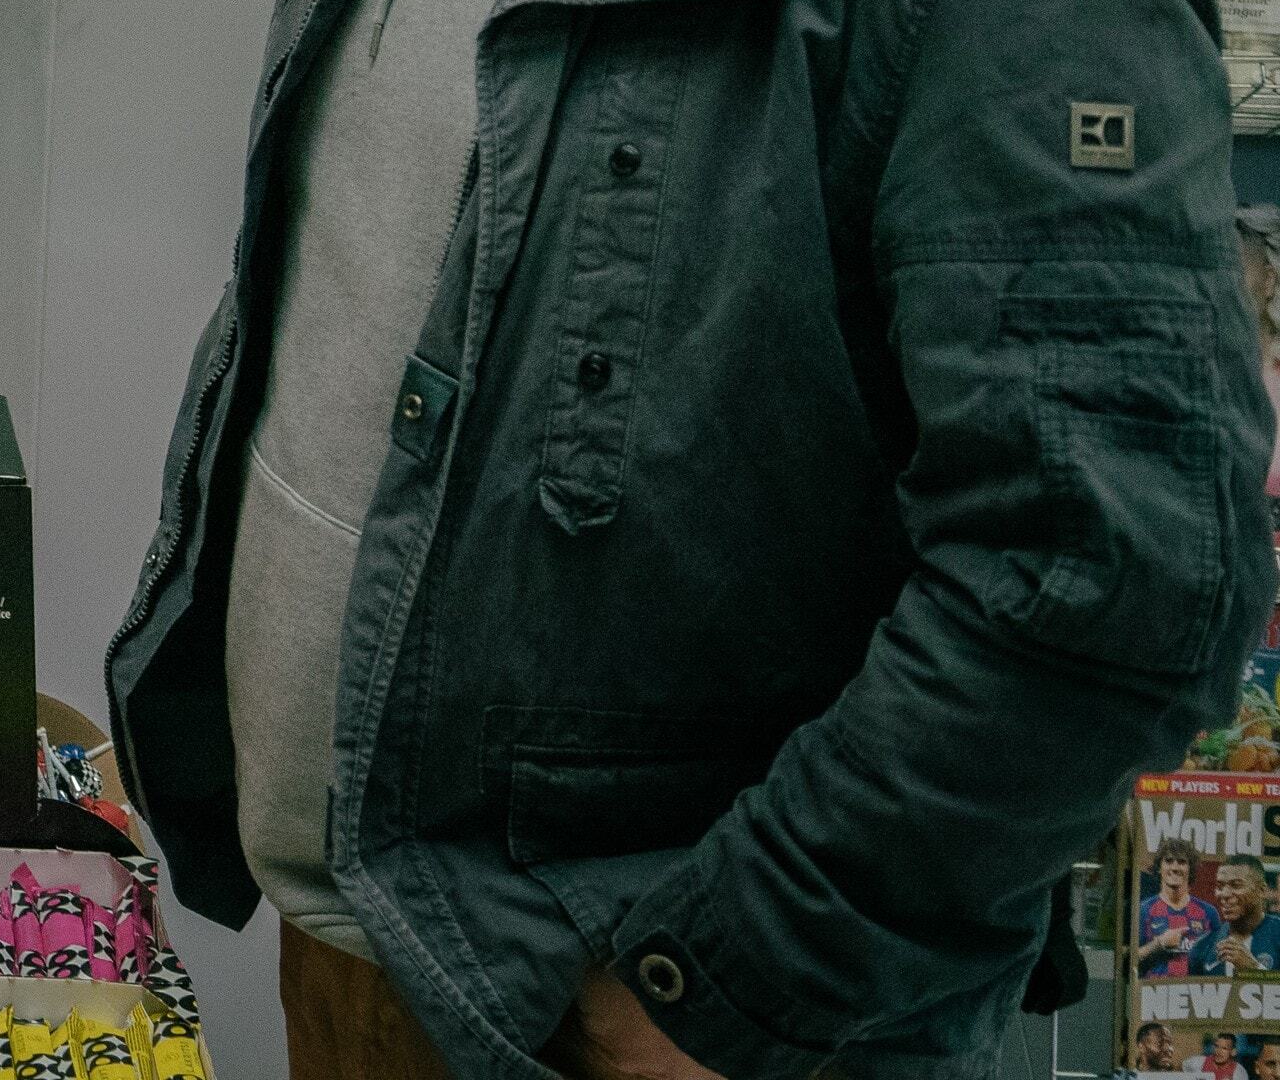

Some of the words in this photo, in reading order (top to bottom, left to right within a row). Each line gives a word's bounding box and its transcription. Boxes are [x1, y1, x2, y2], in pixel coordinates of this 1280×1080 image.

[1141, 778, 1169, 793] NEW
[1171, 780, 1220, 794] PLAYERS
[1236, 782, 1264, 795] NEW
[1265, 783, 1280, 796] TE
[1139, 799, 1263, 857] World
[1141, 982, 1231, 1020] NEW
